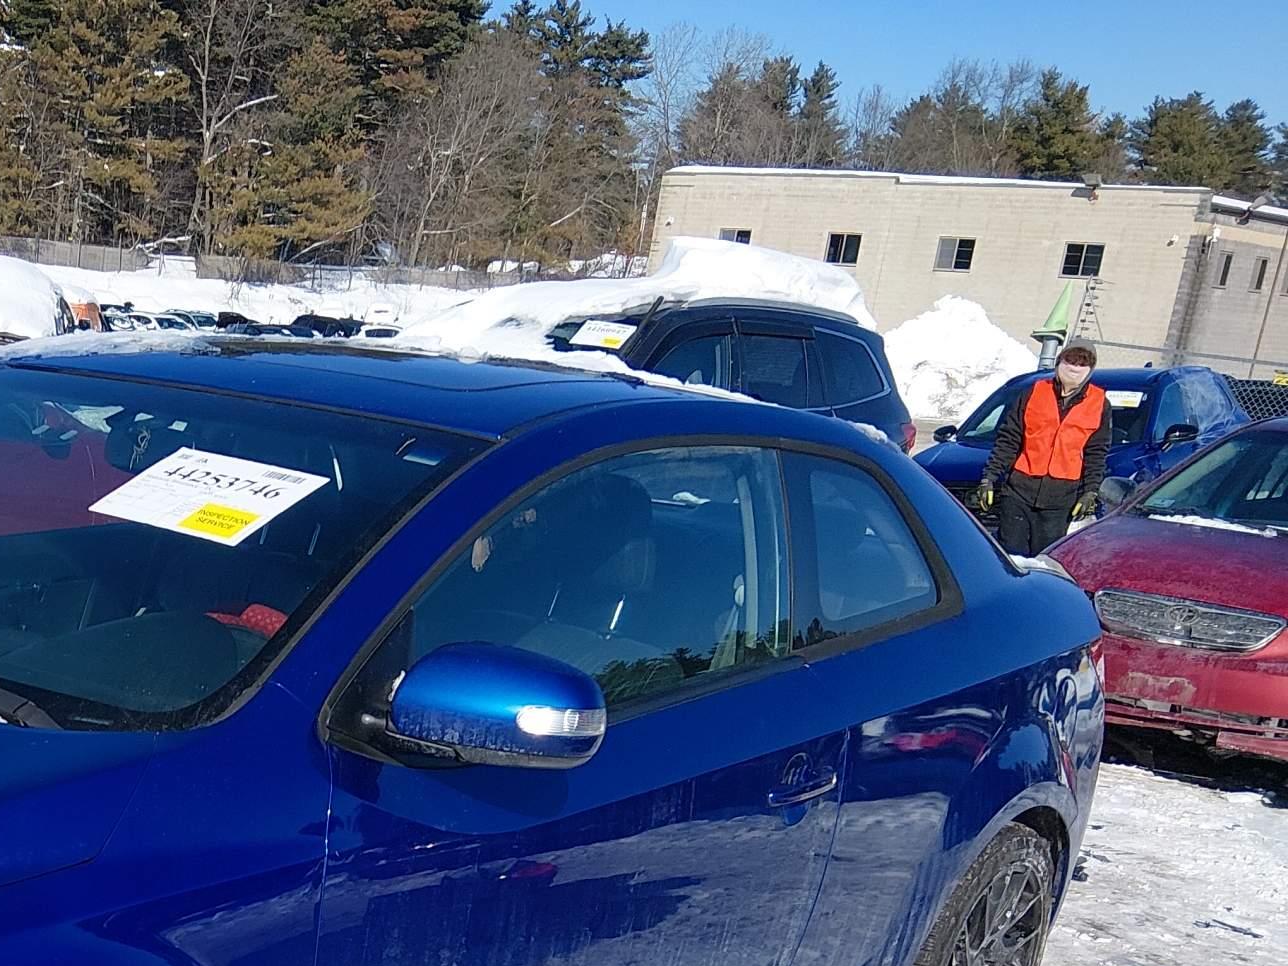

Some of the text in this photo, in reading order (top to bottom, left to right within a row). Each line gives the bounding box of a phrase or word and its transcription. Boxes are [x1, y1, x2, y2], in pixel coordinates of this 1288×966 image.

[163, 465, 285, 500] 44253746
[196, 517, 236, 530] SERVICE
[197, 509, 251, 526] INSPECTION
